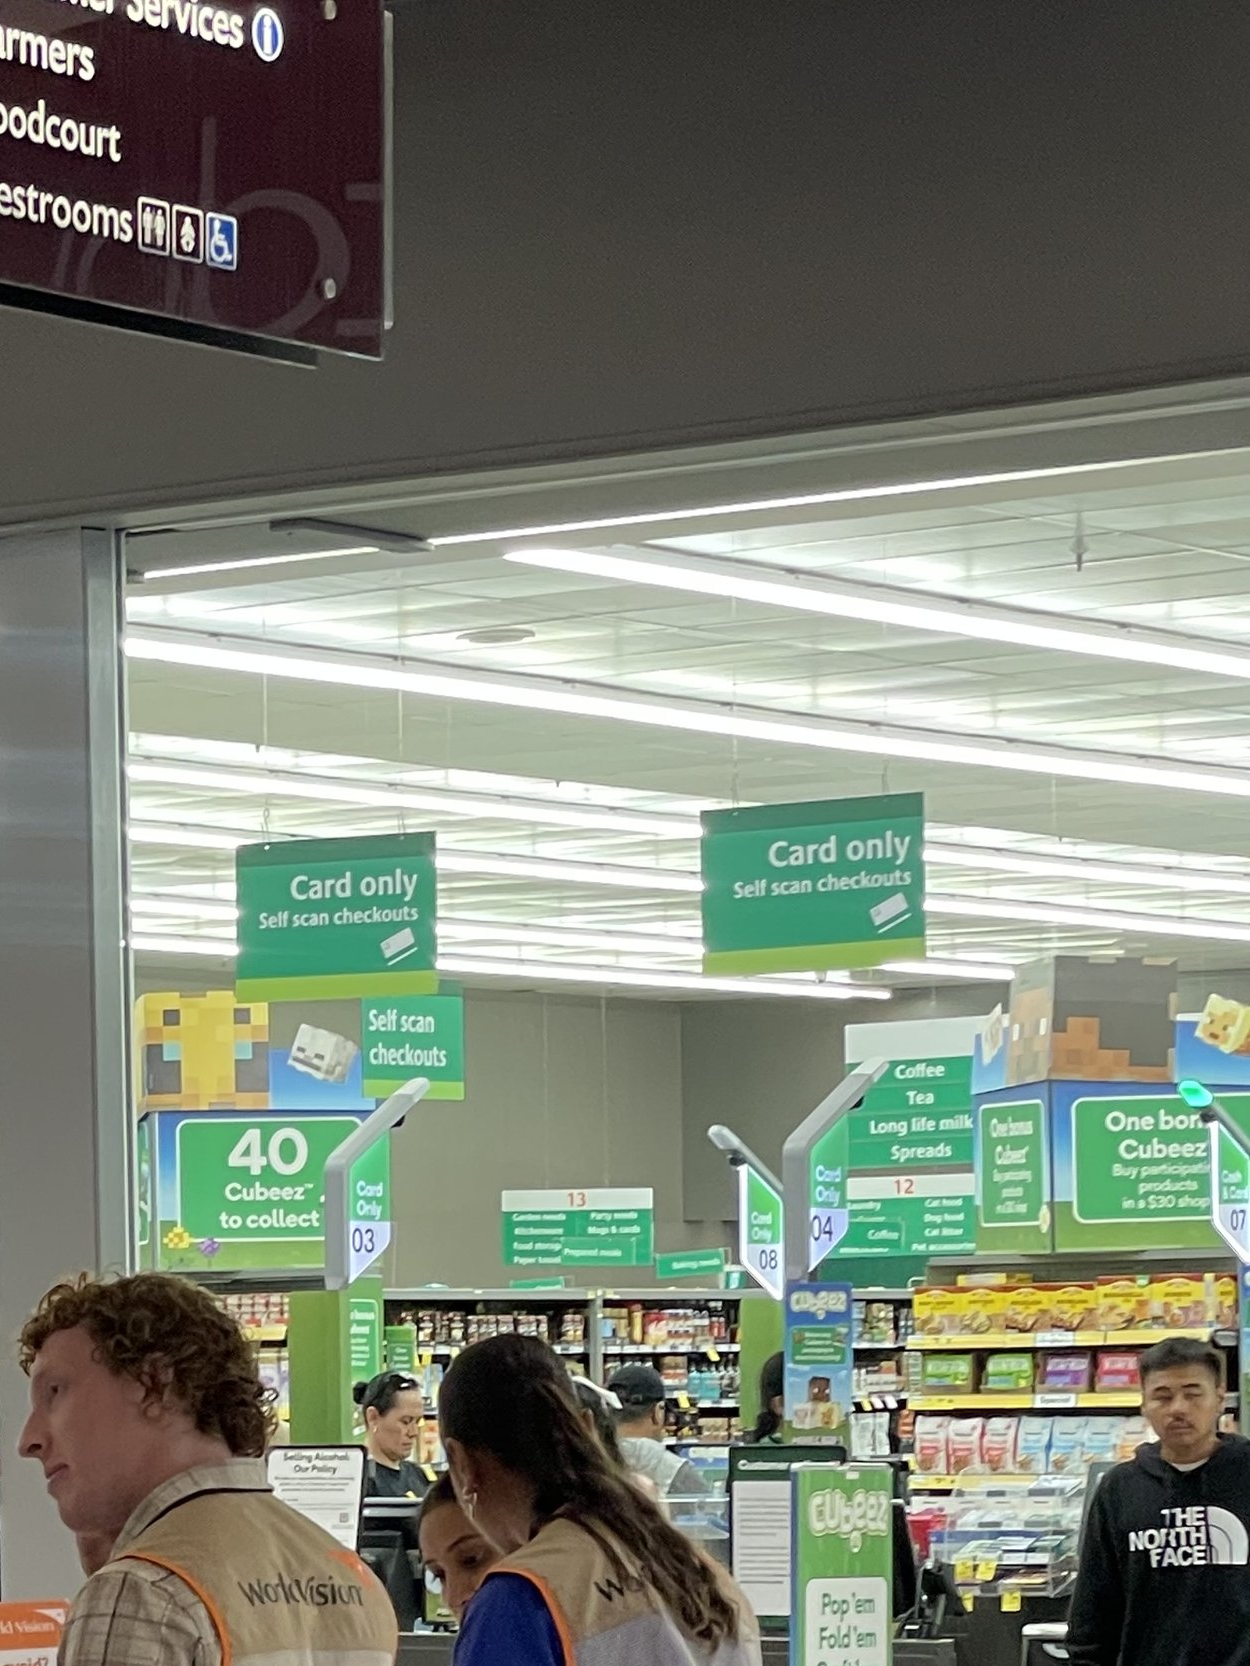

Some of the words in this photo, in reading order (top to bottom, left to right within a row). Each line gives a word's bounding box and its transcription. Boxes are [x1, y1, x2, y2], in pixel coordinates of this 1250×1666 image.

[126, 0, 244, 49] Services
[768, 833, 838, 868] Card
[846, 830, 911, 866] only
[290, 872, 351, 901] Card
[359, 868, 418, 901] only
[733, 879, 767, 899] Self
[771, 880, 812, 897] scan
[817, 867, 911, 893] checkouts
[259, 910, 289, 930] Self
[292, 912, 329, 928] scan
[332, 905, 419, 926] checkouts
[368, 1007, 397, 1032] Self
[400, 1013, 435, 1033] scan
[369, 1041, 447, 1067] checkouts
[894, 1061, 945, 1079] Coffee
[907, 1090, 935, 1105] Tea
[869, 1118, 908, 1137] Long
[911, 1115, 937, 1132] life
[939, 1112, 973, 1130] milk
[1105, 1111, 1154, 1132] One
[228, 1127, 308, 1176] 40
[890, 1141, 952, 1161] Spreads
[1118, 1137, 1208, 1160] Cubeez
[815, 1165, 842, 1182] Card
[1112, 1163, 1138, 1180] Buy
[356, 1180, 383, 1197] Card
[815, 1186, 841, 1207] Only
[893, 1179, 914, 1195] 12
[356, 1200, 382, 1220] Only
[567, 1192, 587, 1207] 13
[219, 1211, 242, 1230] to
[246, 1210, 320, 1230] collect
[811, 1215, 833, 1242] 04
[1230, 1209, 1246, 1231] 07
[352, 1228, 375, 1253] 03
[759, 1250, 778, 1269] 08
[1162, 1506, 1207, 1526] THE
[1128, 1525, 1207, 1552] NORTH
[1150, 1544, 1209, 1569] FACE
[822, 1592, 850, 1622] Pop
[819, 1626, 851, 1649] Fold
